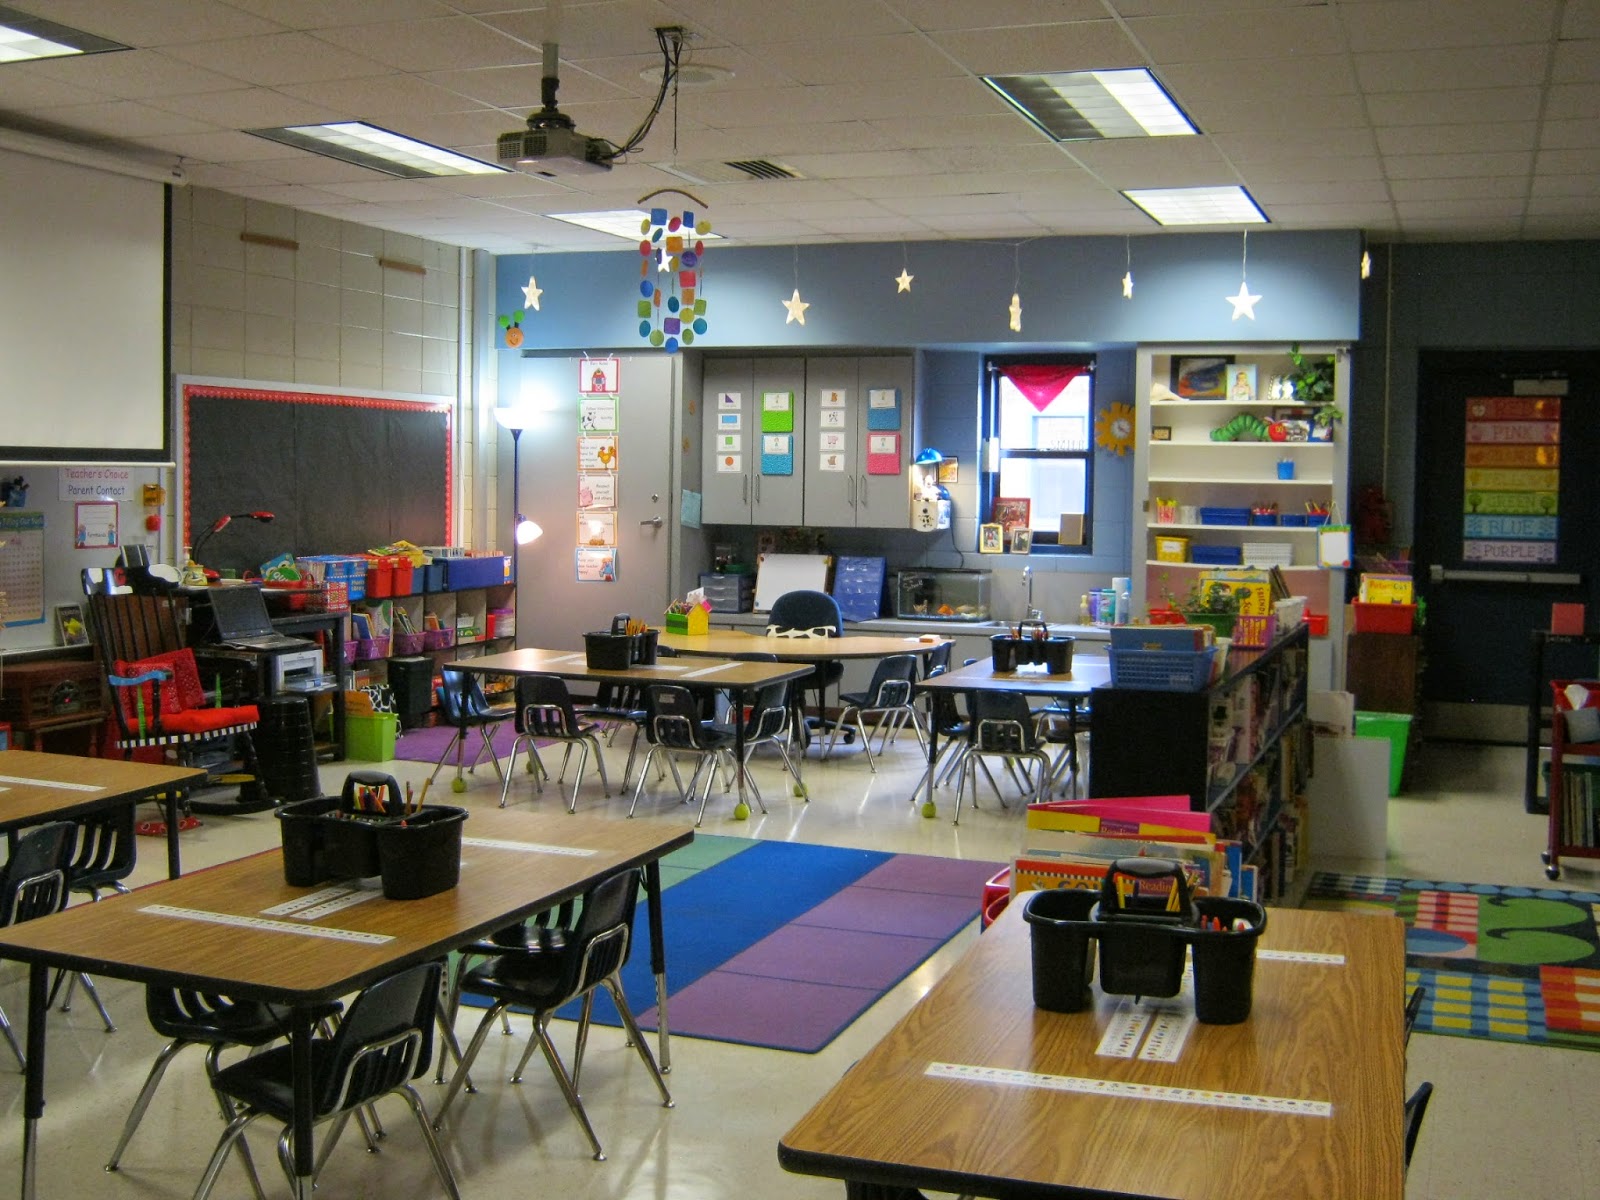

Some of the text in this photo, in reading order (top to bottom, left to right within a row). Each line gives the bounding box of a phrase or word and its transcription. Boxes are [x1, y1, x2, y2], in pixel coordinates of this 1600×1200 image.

[1493, 426, 1533, 439] PINK
[64, 468, 129, 479] Teacher's Choice
[68, 485, 125, 495] Parent Contact
[1488, 519, 1535, 535] BLUE
[1484, 543, 1536, 558] PURPLE
[1139, 880, 1172, 892] Readin
